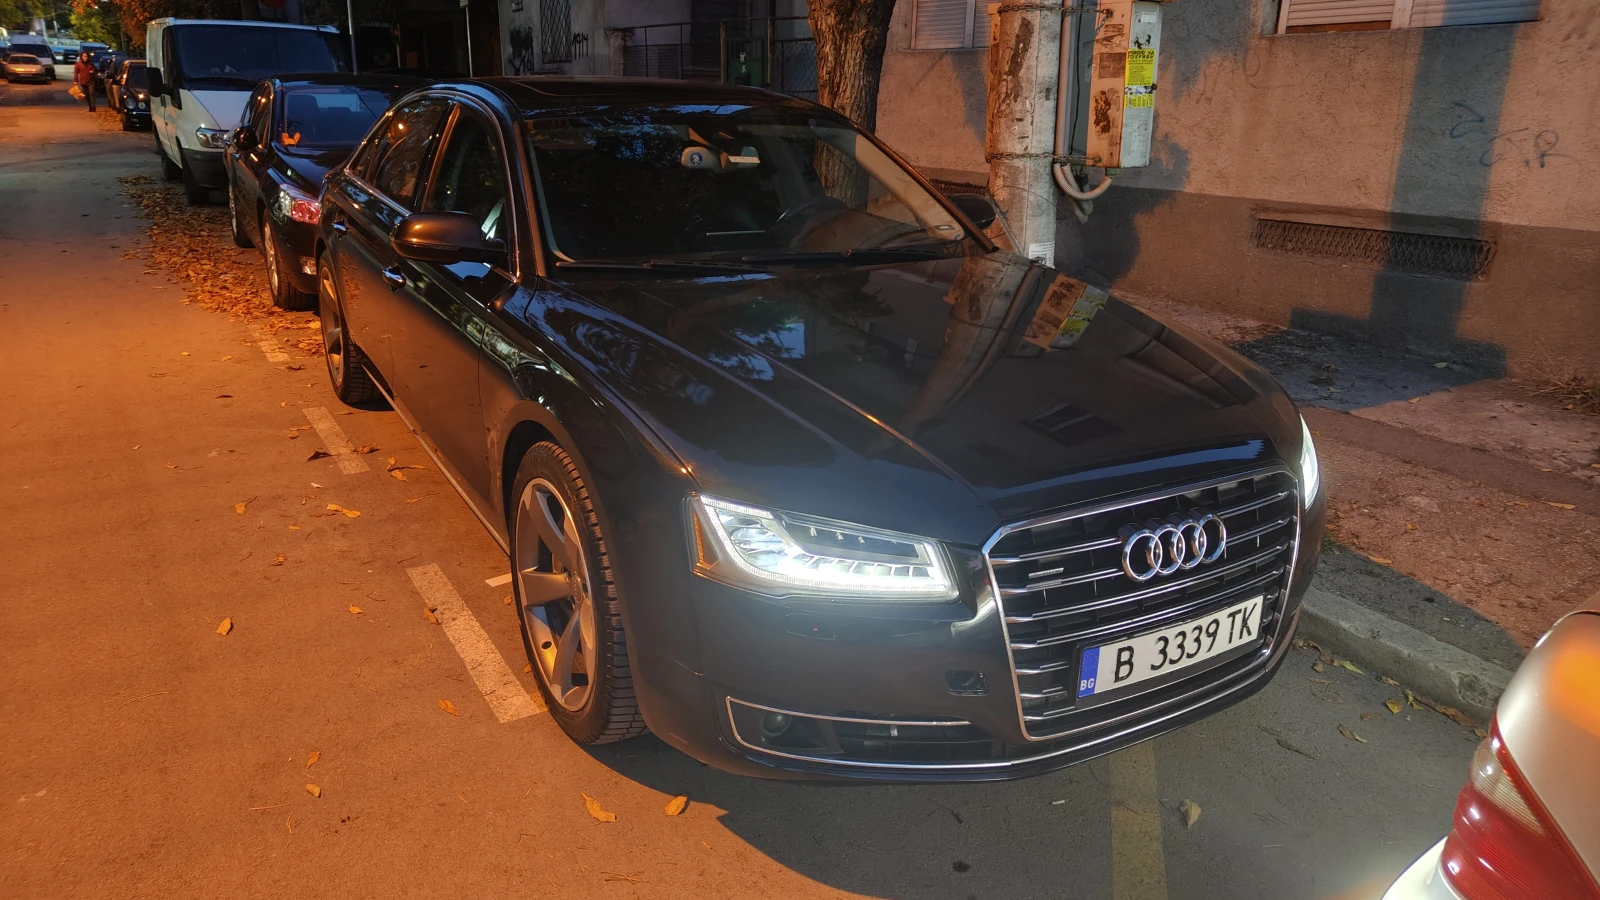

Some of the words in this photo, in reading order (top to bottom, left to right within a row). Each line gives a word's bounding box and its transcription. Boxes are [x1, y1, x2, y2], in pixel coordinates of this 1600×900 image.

[1113, 645, 1135, 684] B
[1150, 618, 1221, 671] 3339
[1227, 603, 1258, 645] TK
[1079, 677, 1095, 691] BG
